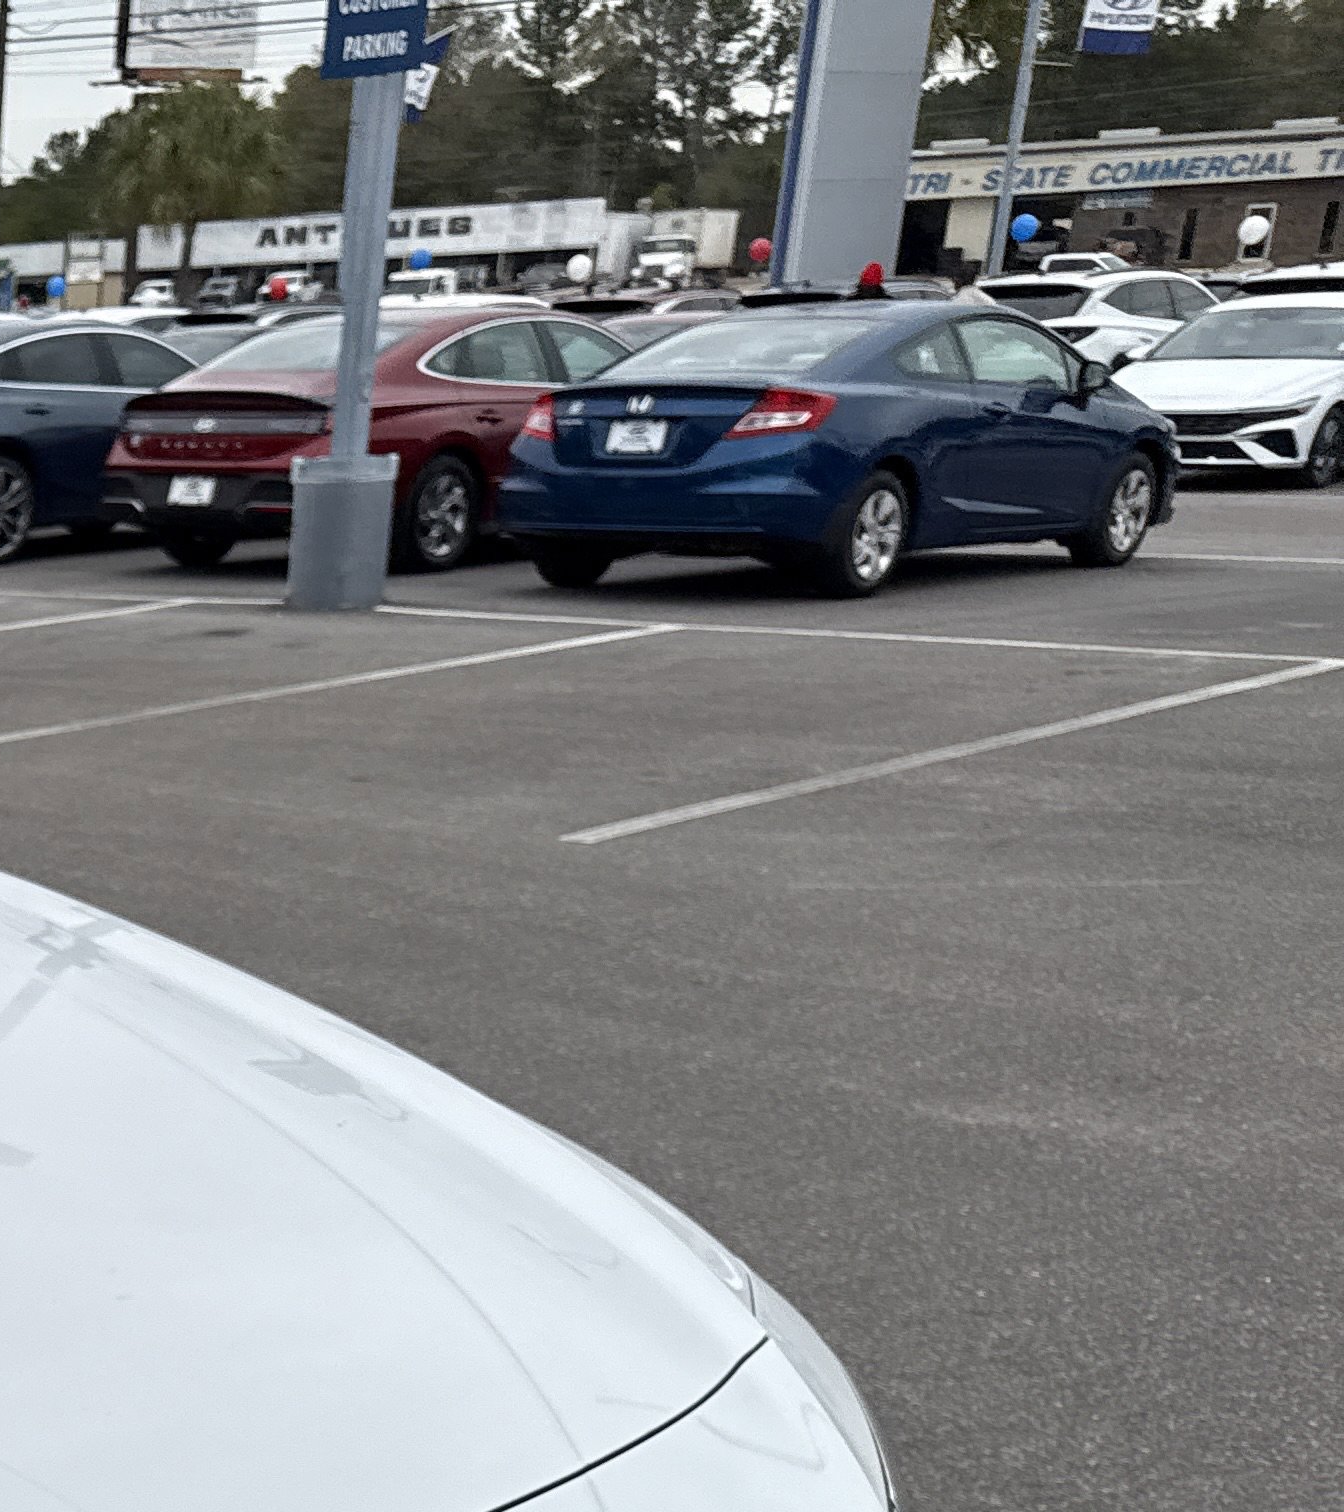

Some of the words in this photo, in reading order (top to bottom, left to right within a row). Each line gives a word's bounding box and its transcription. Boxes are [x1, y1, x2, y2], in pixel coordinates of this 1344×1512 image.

[343, 29, 409, 61] PARKING
[910, 171, 951, 196] TRI
[1089, 150, 1297, 186] COMMERCIAL
[256, 216, 473, 247] ANTUES
